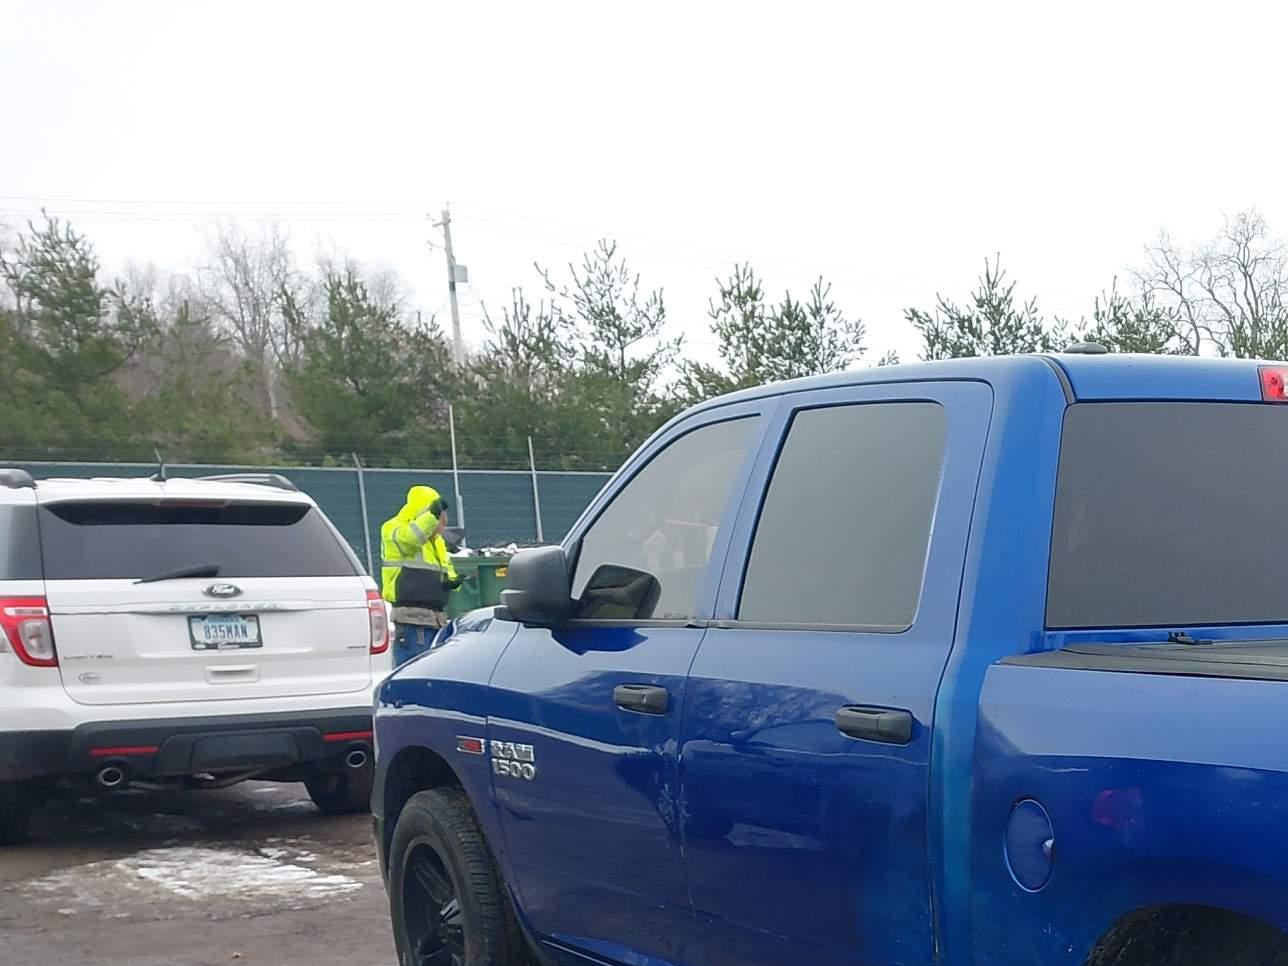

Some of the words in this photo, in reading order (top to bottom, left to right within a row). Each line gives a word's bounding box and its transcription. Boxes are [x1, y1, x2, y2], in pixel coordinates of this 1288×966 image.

[203, 622, 249, 640] 835MAN
[490, 740, 535, 762] RAM
[490, 758, 537, 782] 1500
